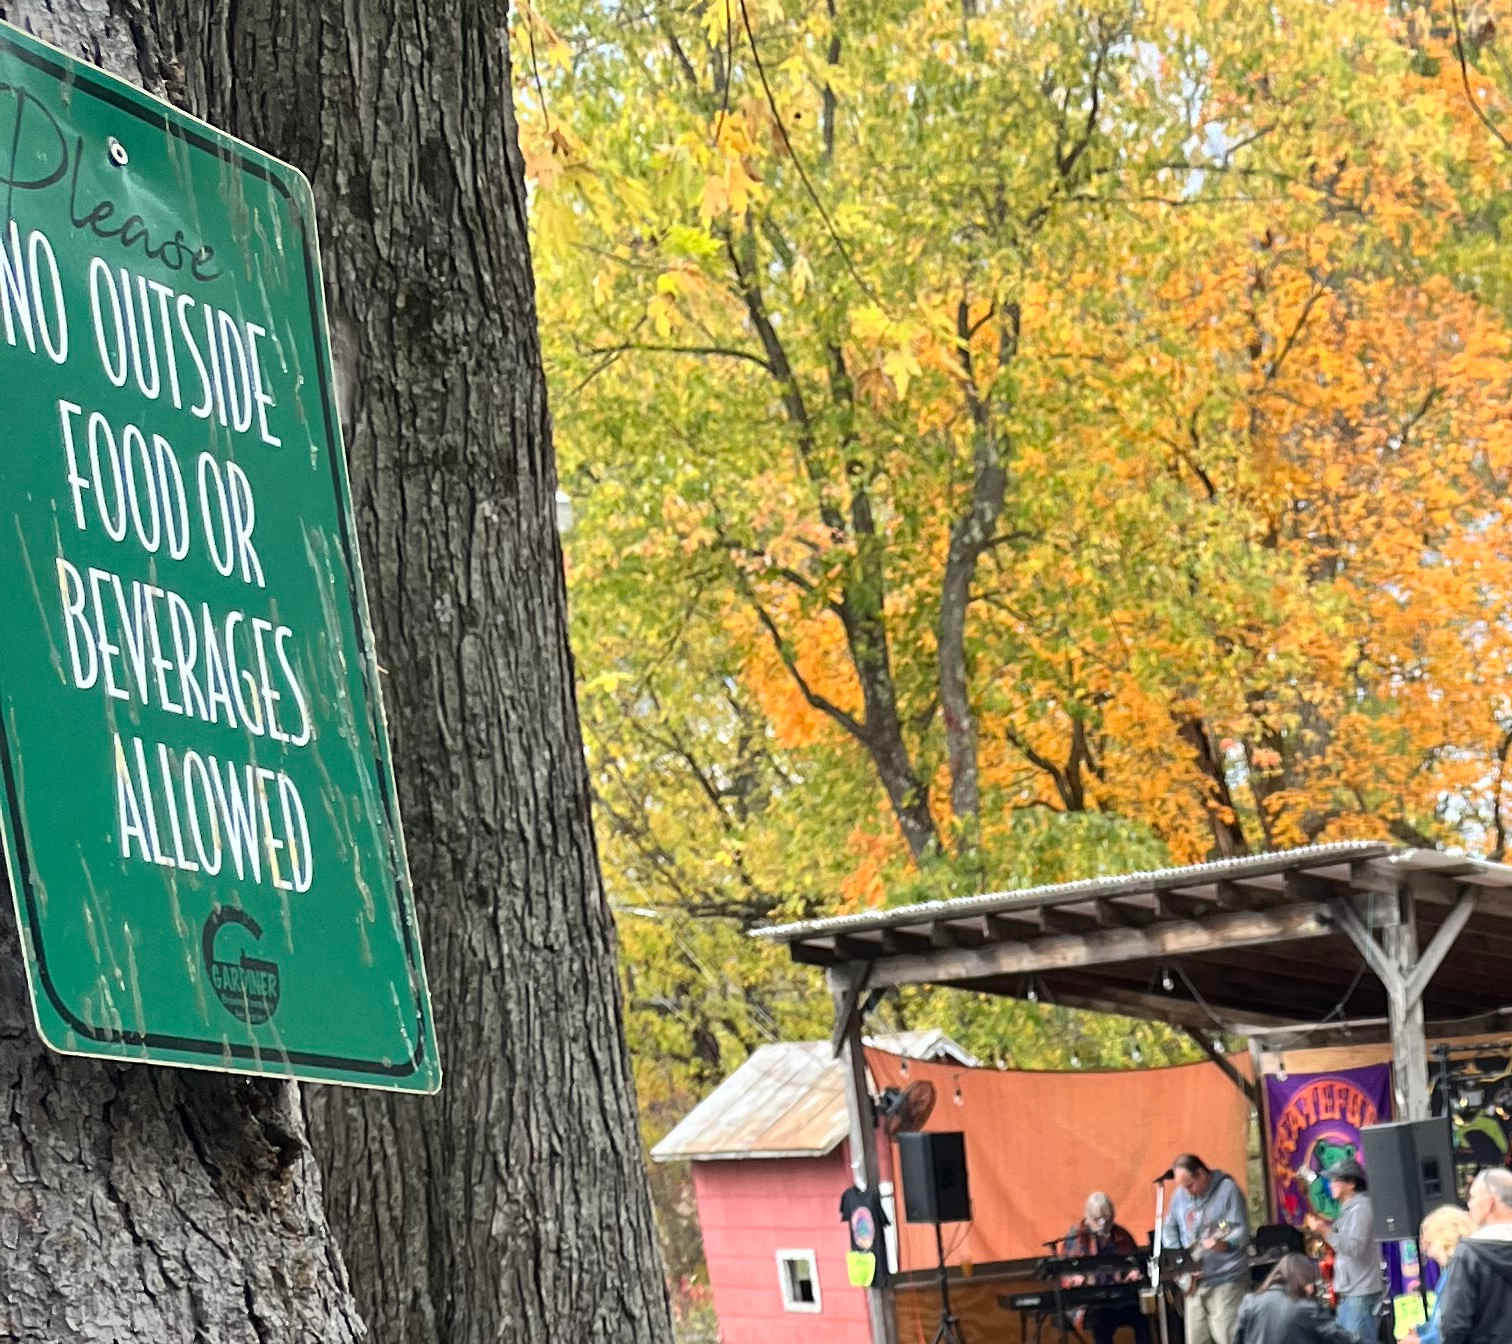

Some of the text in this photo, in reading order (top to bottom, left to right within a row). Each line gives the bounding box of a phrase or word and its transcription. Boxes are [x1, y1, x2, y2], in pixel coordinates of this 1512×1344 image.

[0, 82, 224, 282] Please
[0, 220, 281, 448] NO OUTSIDE
[60, 399, 265, 588] FOOD OR
[56, 557, 310, 747] BEVERAGES
[114, 732, 313, 893] ALLOWED
